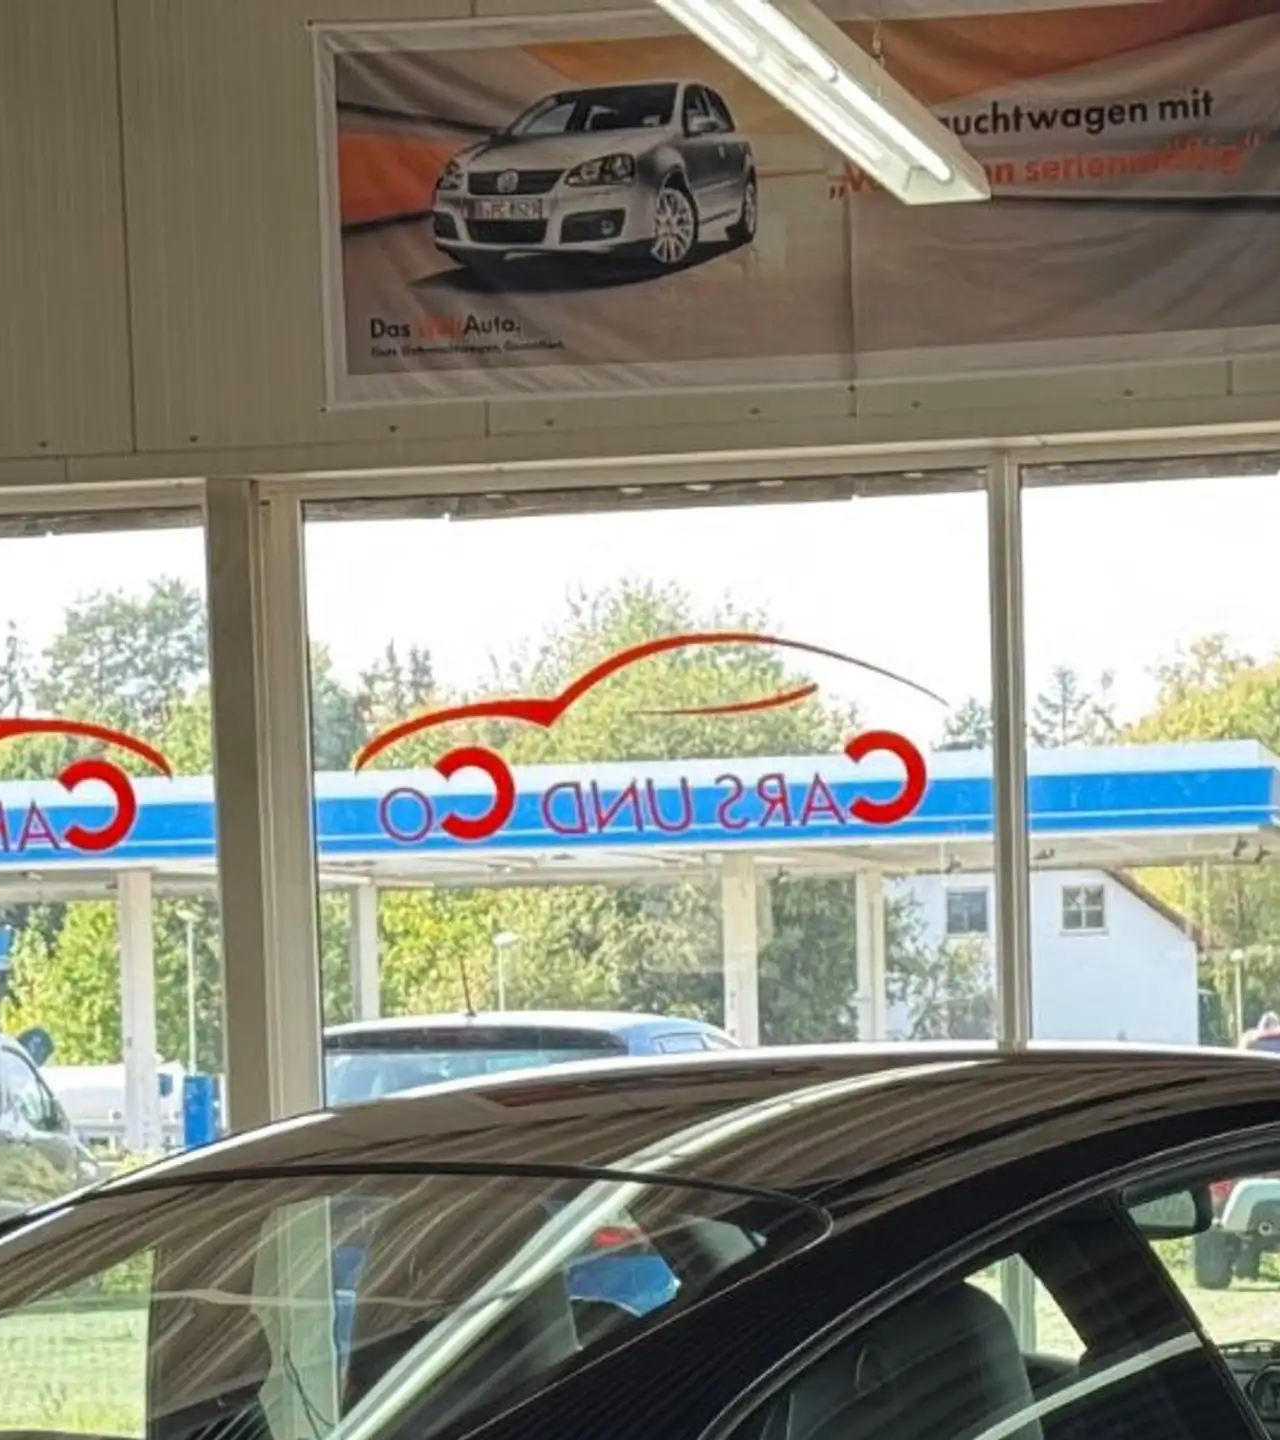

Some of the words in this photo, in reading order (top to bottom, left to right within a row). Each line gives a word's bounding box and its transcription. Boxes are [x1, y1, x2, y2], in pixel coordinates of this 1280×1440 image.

[1158, 87, 1214, 121] mit
[371, 318, 411, 339] Das
[415, 314, 521, 340] Auto.
